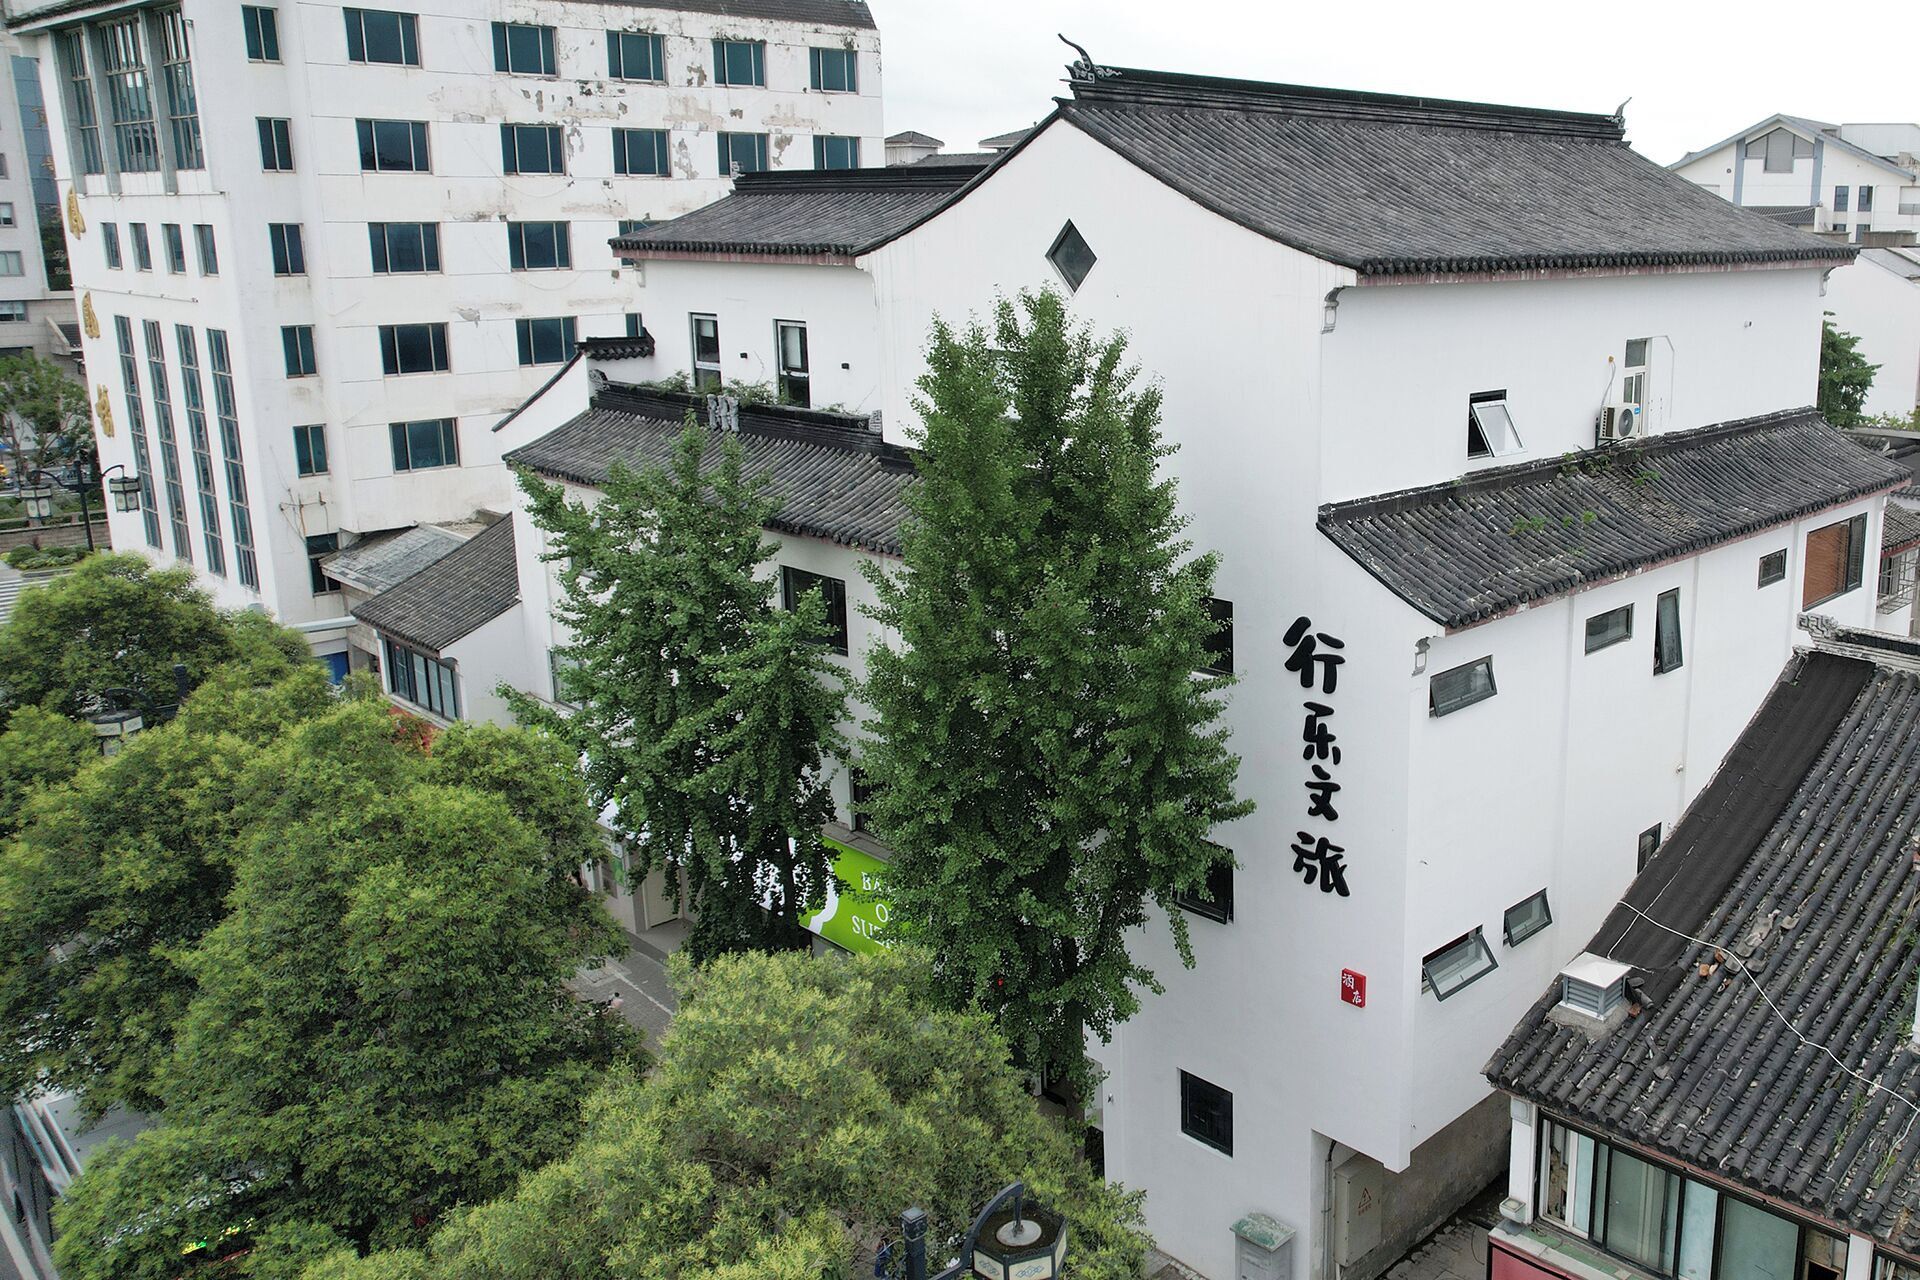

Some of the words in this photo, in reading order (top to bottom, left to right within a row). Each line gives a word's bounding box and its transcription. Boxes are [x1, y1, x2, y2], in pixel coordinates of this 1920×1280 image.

[1282, 616, 1350, 897] 行乐文旅
[876, 903, 893, 923] O
[1342, 972, 1363, 1005] 酒店
